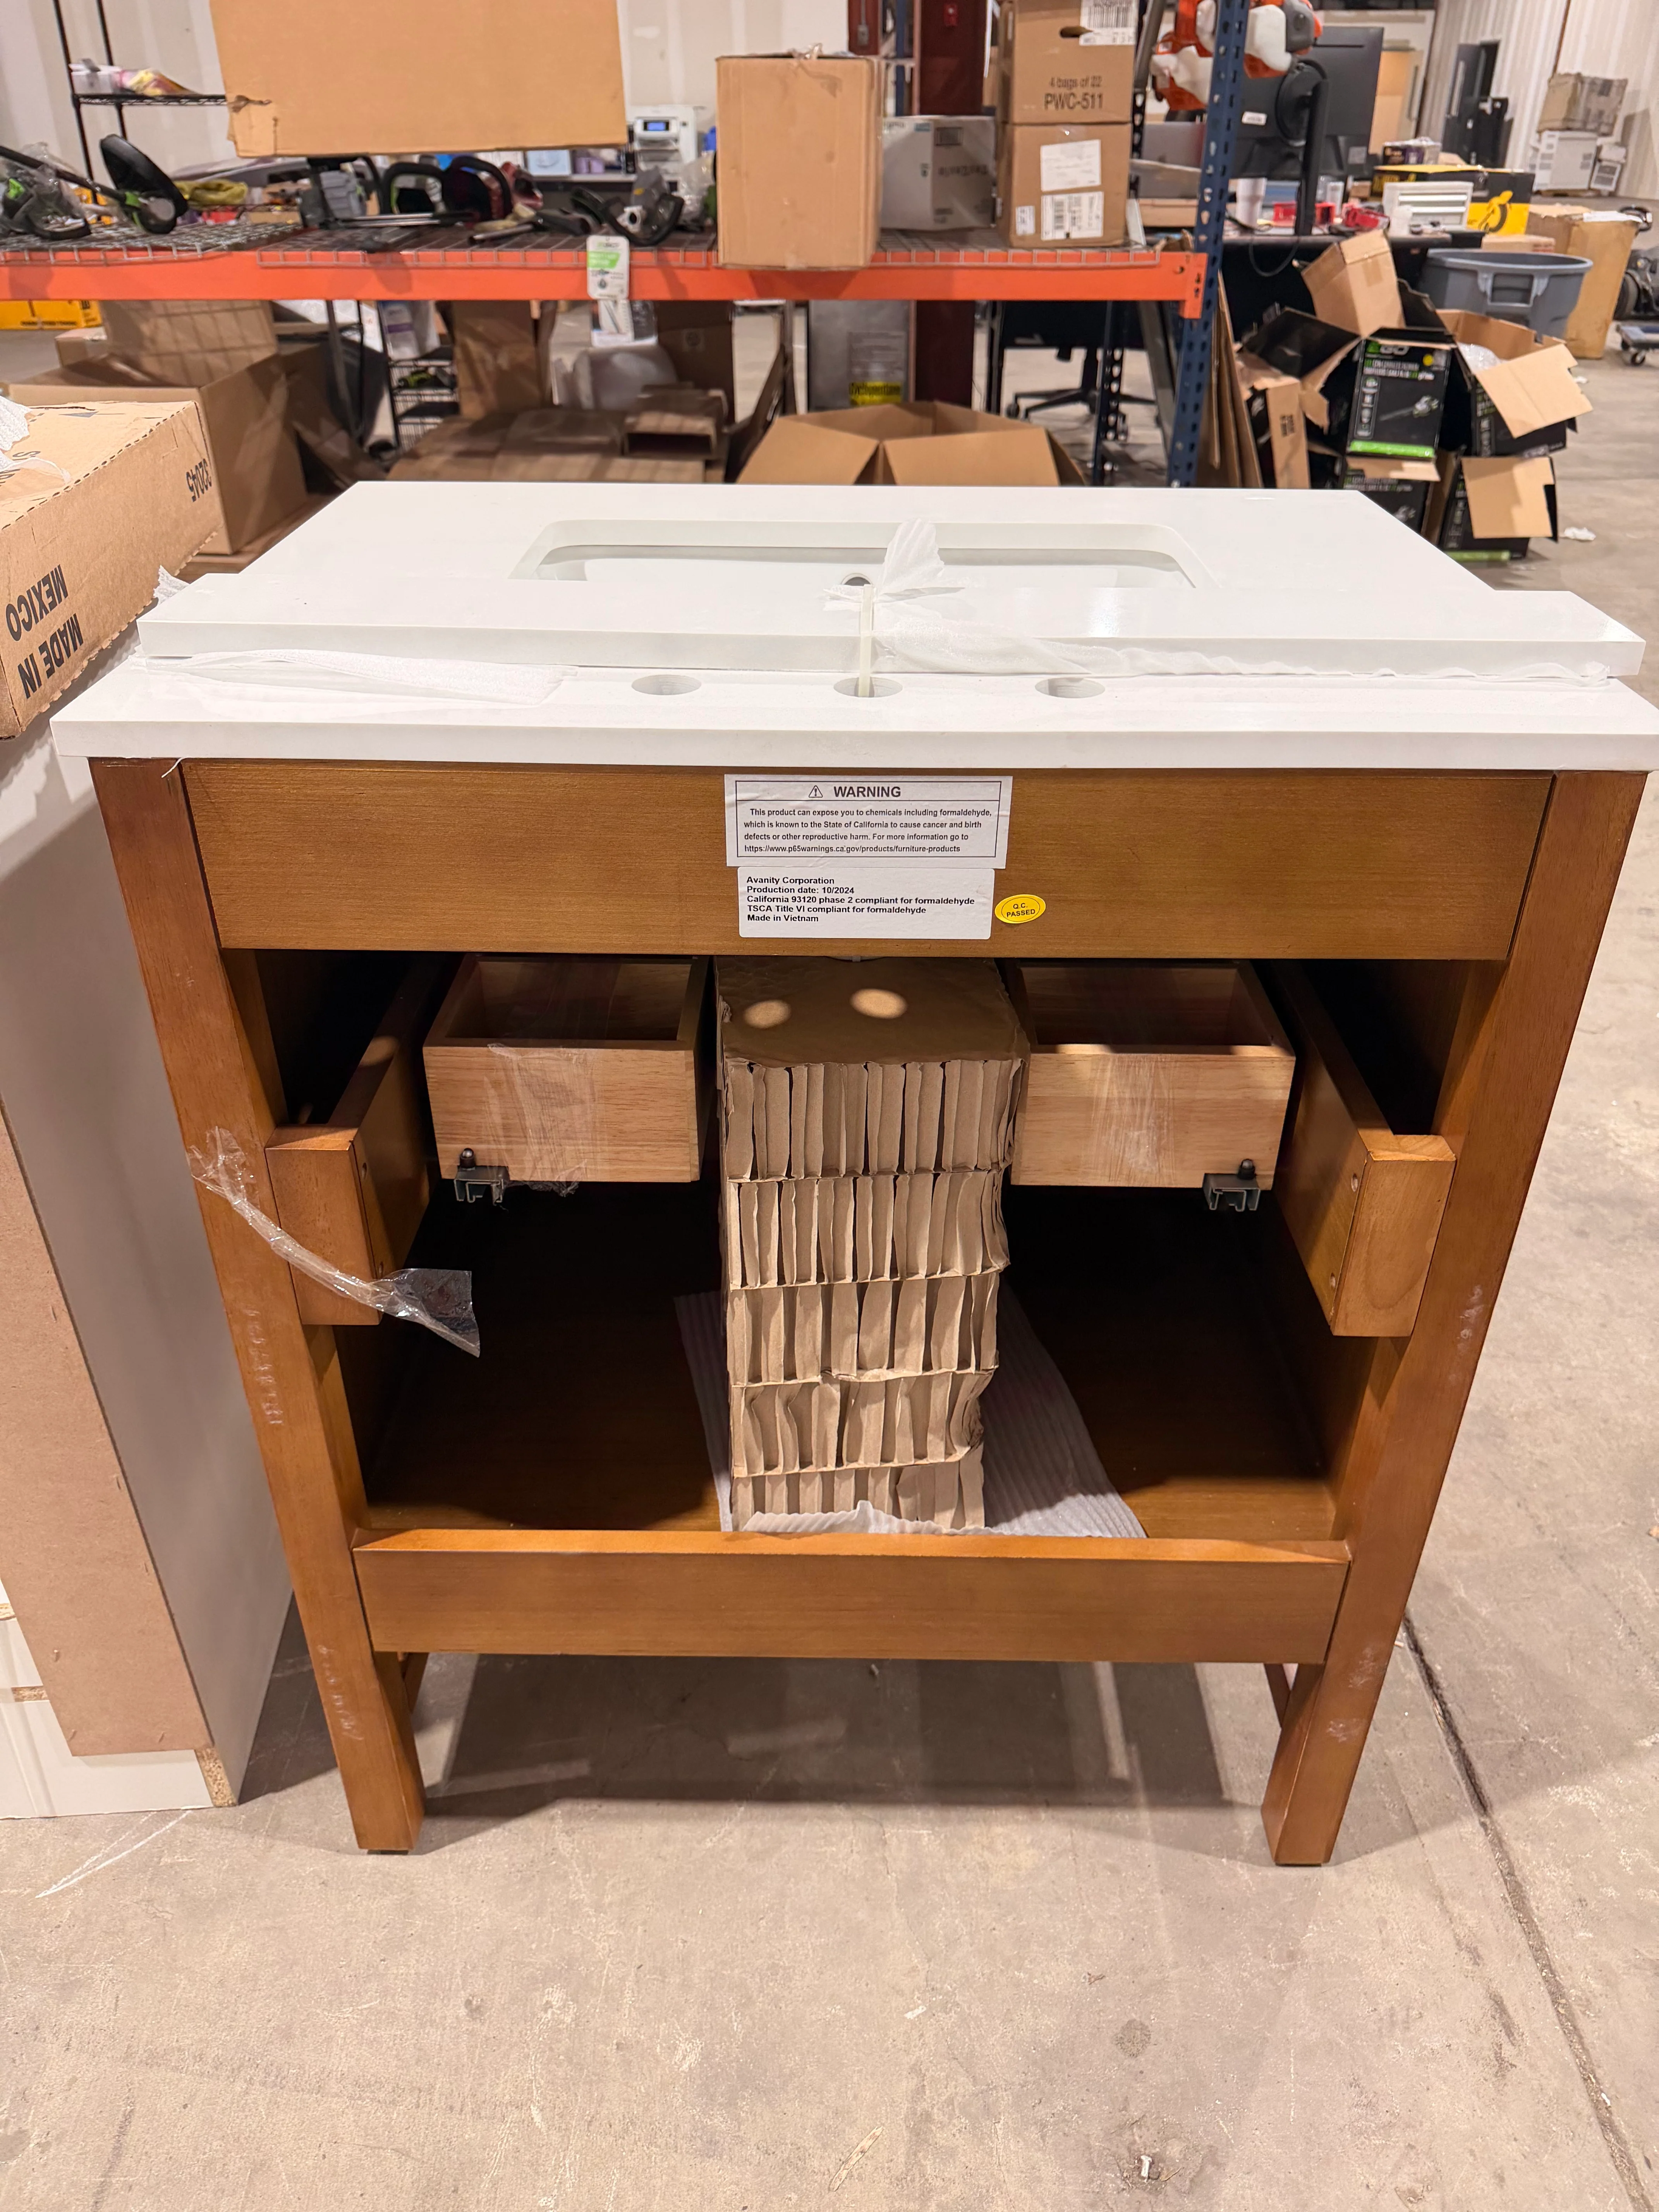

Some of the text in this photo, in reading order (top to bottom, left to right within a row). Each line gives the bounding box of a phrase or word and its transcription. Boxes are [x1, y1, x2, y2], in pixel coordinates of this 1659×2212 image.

[1044, 92, 1103, 110] PWC-511
[186, 459, 212, 502] 32045
[5, 564, 69, 642] MEXICO
[17, 613, 84, 699] MADE IN
[834, 786, 901, 797] WARNING
[905, 809, 938, 817] including
[939, 809, 991, 817] formaldehyde,
[802, 833, 848, 842] reproductive
[747, 876, 834, 885] Avanity Corporation
[867, 907, 926, 915] formaldehyde
[1006, 908, 1036, 917] PASSED
